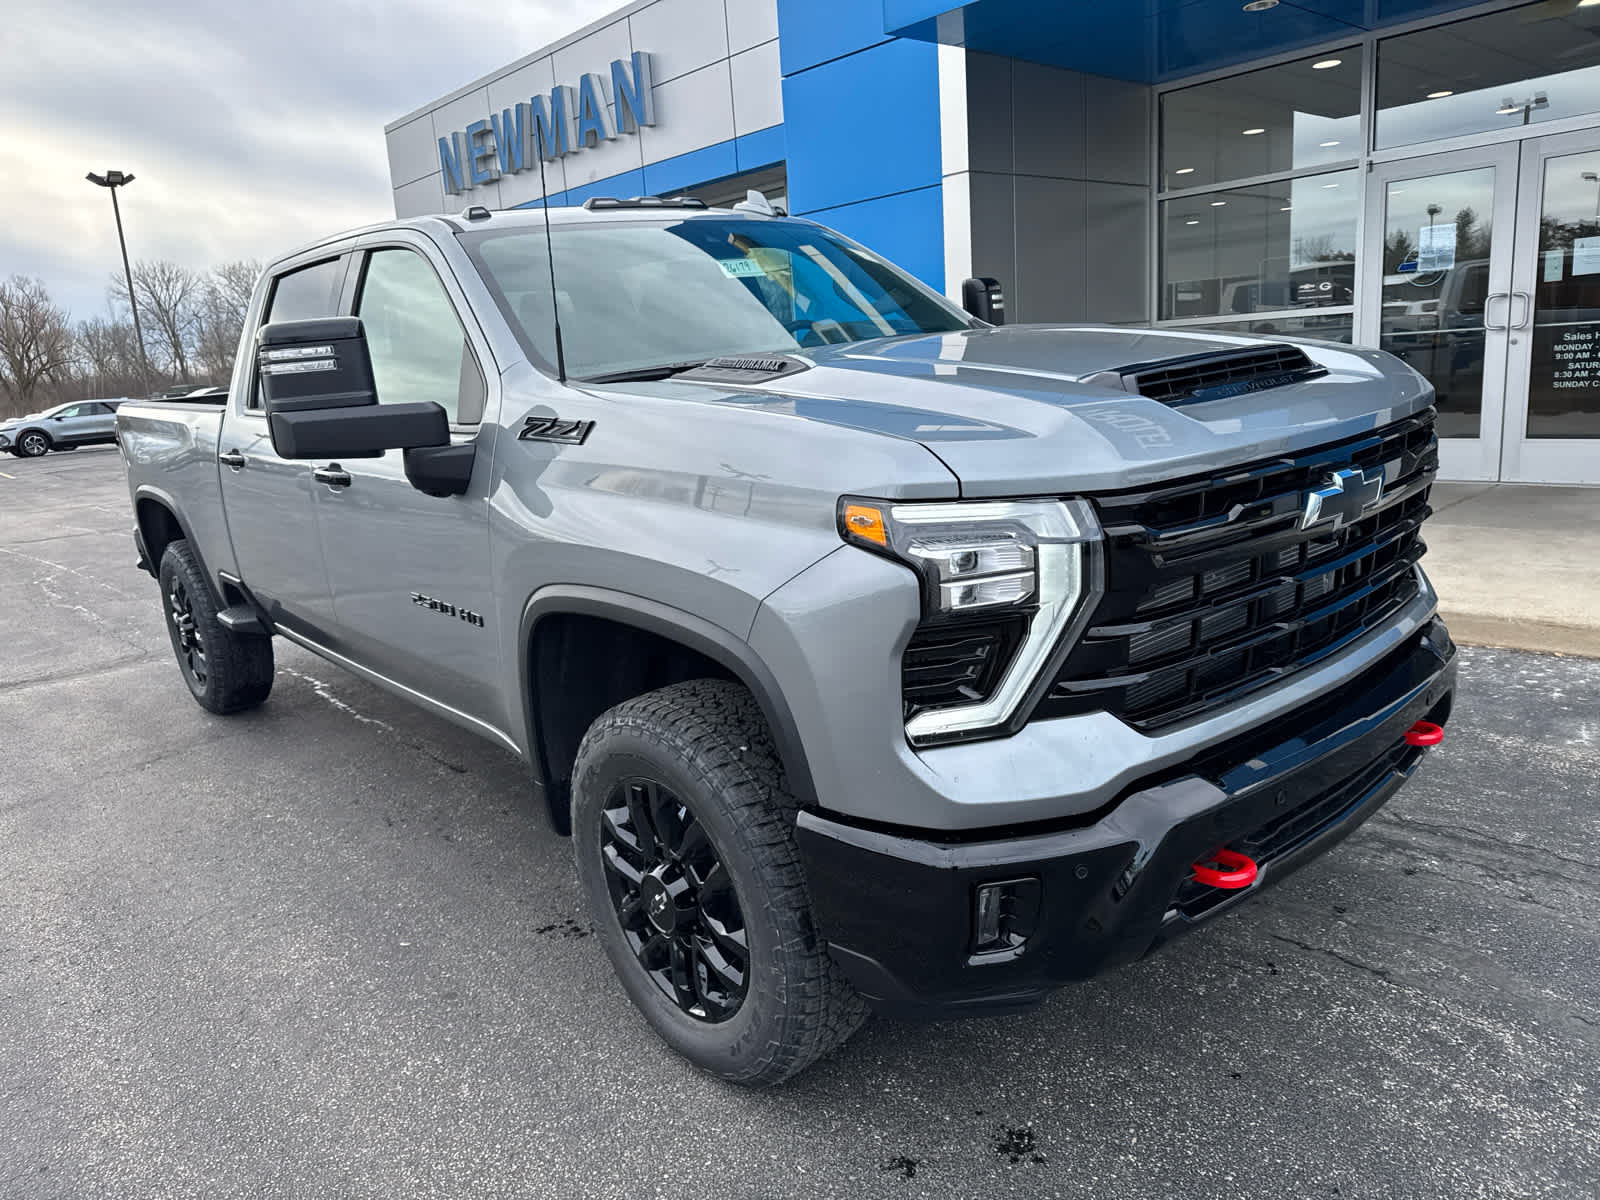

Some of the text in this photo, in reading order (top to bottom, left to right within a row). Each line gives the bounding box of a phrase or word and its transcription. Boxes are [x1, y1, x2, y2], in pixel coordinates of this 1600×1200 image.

[438, 50, 656, 195] NEWMAN
[1563, 332, 1592, 341] Sales
[1553, 343, 1593, 351] MONDAY
[1555, 352, 1574, 360] 9:00
[1575, 351, 1590, 359] AM
[1554, 370, 1572, 378] 8:30
[1574, 370, 1589, 378] AM
[1552, 380, 1590, 388] SUNDAY
[517, 416, 596, 446] Z71
